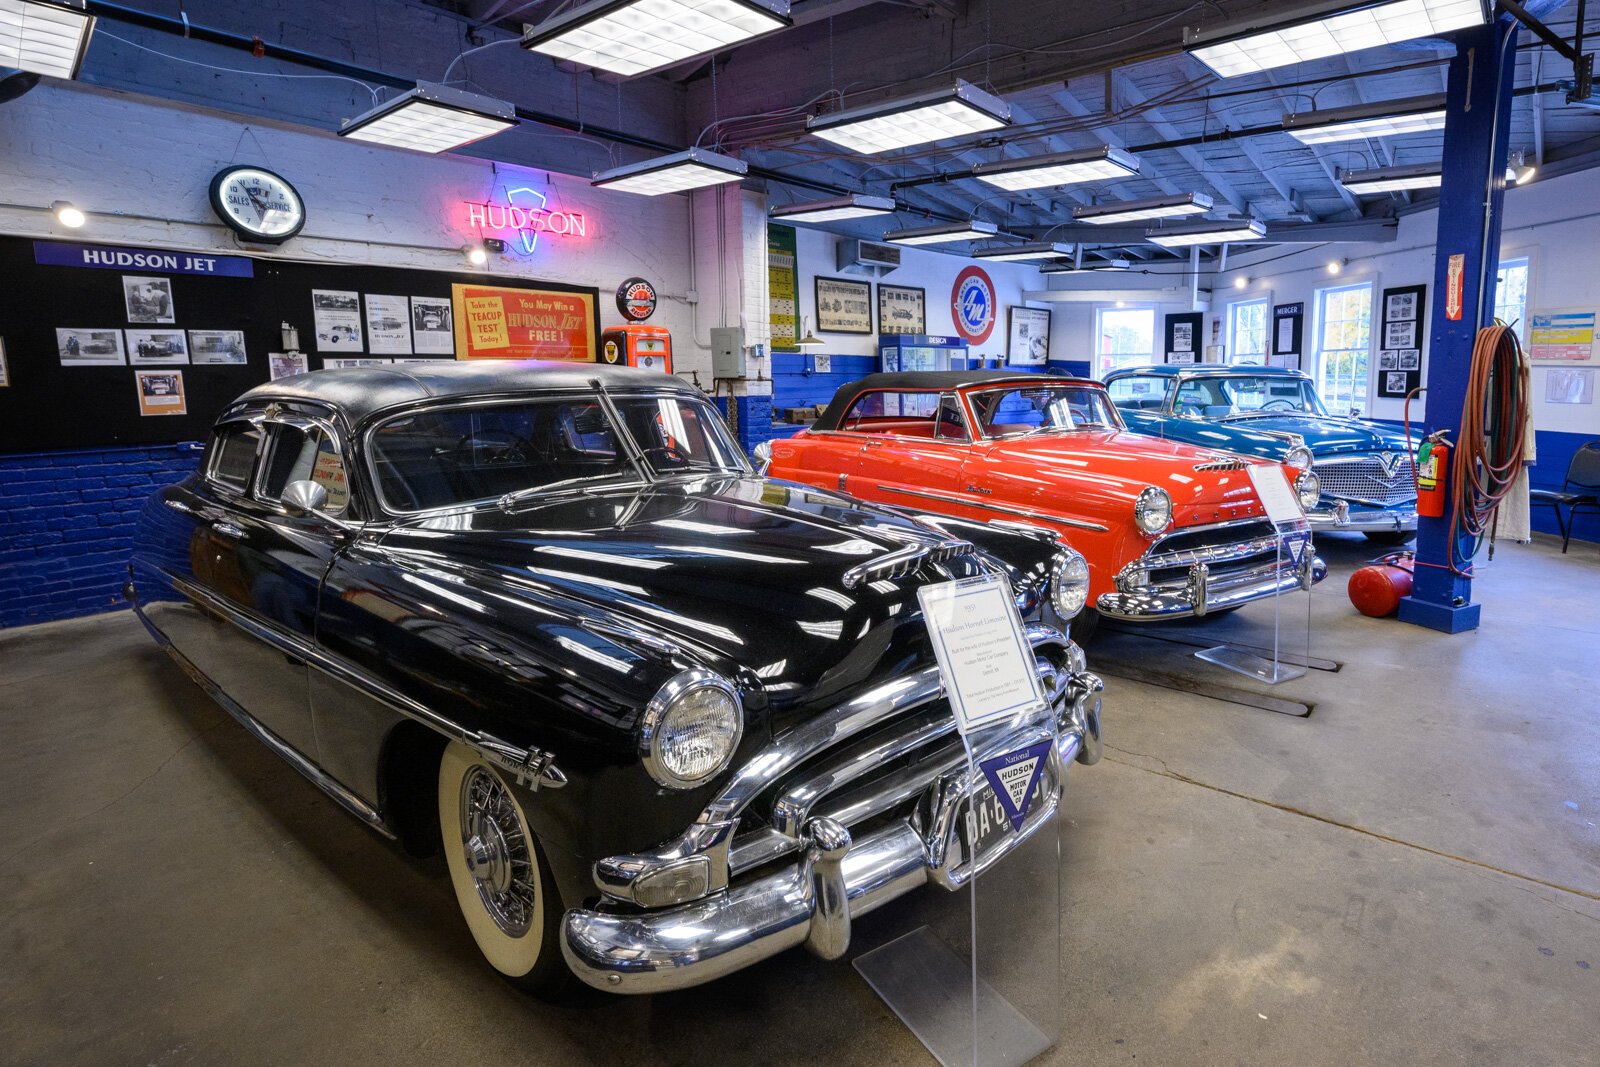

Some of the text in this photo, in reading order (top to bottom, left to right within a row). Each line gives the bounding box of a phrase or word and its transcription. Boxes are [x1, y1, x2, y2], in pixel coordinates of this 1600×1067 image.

[228, 196, 292, 212] SALES SERVICE
[469, 204, 585, 237] HUDSON
[83, 249, 216, 272] HUDSON JET
[628, 284, 654, 298] HUDSON
[960, 279, 990, 313] AMERICAN MOTORS
[471, 301, 486, 309] Take
[519, 298, 534, 309] You
[536, 300, 552, 312] May
[554, 301, 568, 311] Win
[1277, 306, 1298, 315] MERGER
[630, 308, 652, 317] REGULAR
[508, 312, 583, 330] HUDSON JET
[960, 313, 986, 333] CORPORATION
[529, 330, 557, 341] FREE
[943, 625, 964, 633] Hudson
[965, 620, 984, 629] Hornet
[1005, 750, 1030, 765] National
[1002, 762, 1034, 780] HUDSON
[1010, 780, 1027, 790] MOTOR
[1013, 789, 1023, 797] CAR
[1016, 796, 1022, 804] CO
